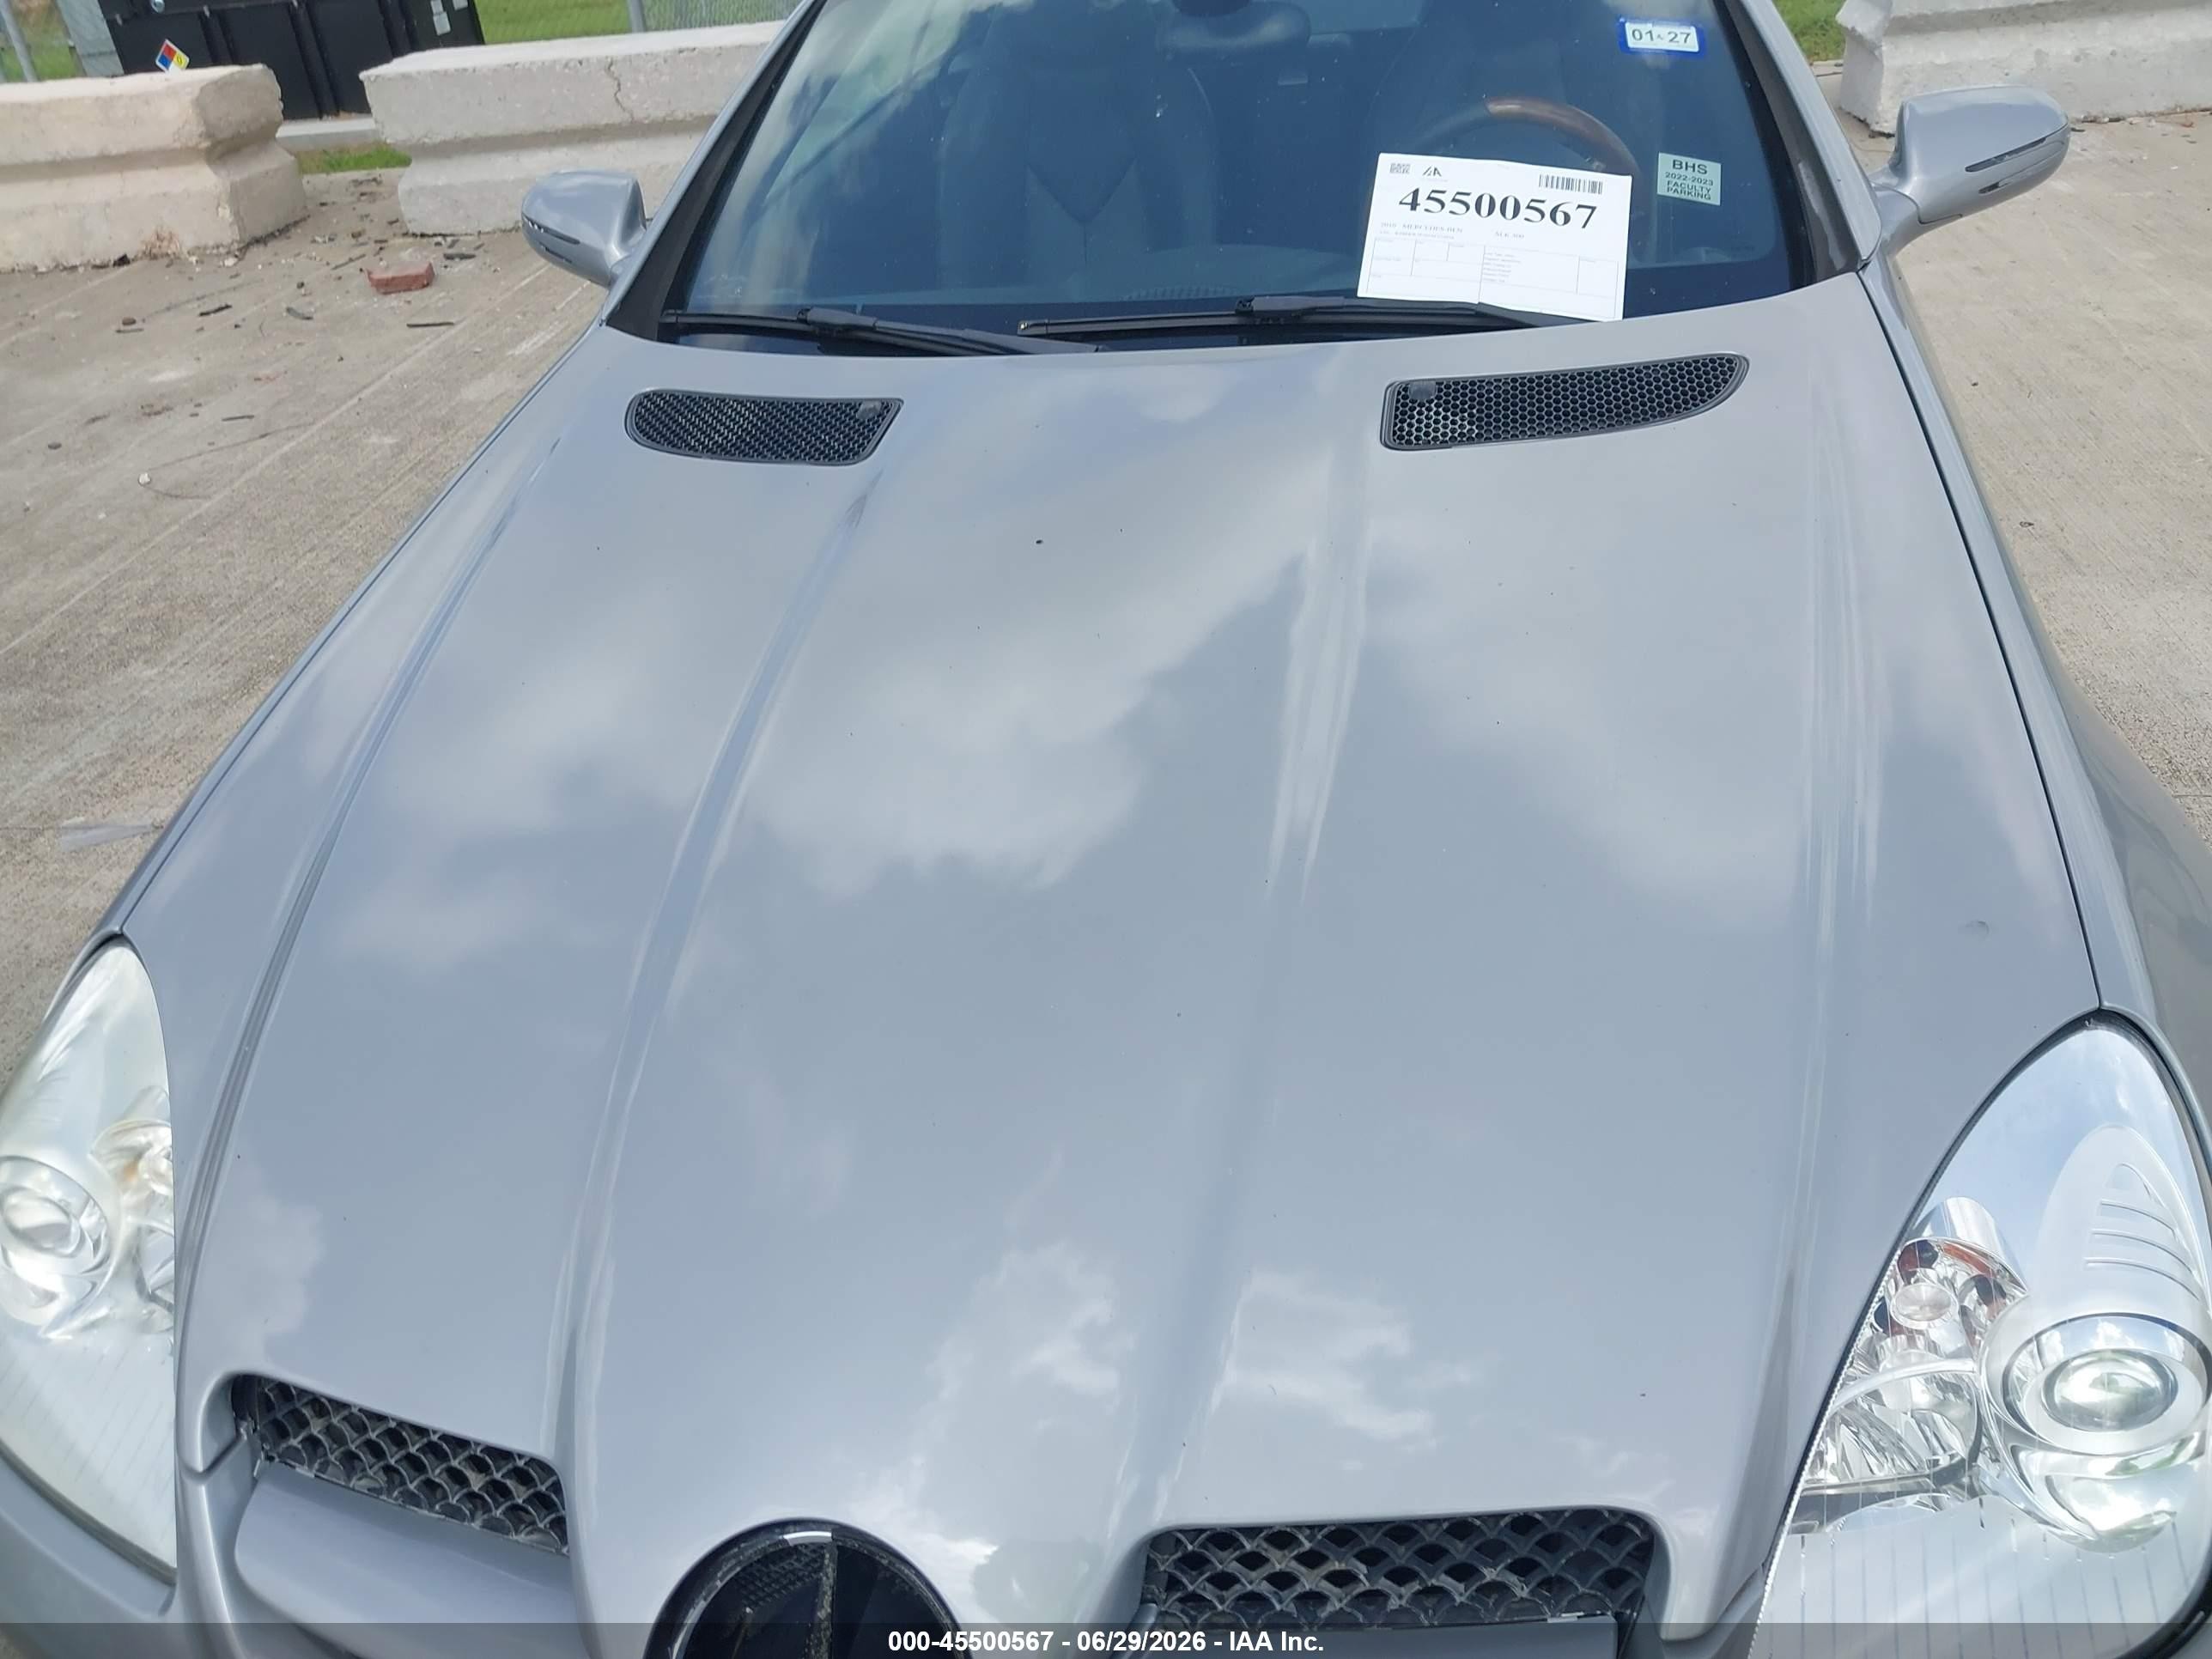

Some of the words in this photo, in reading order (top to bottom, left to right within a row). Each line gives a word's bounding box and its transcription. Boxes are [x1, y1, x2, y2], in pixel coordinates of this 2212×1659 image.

[1632, 28, 1654, 42] 01
[1668, 31, 1692, 44] 27
[1672, 159, 1708, 175] BHS
[1665, 171, 1714, 186] 2022-2023
[1667, 180, 1711, 194] FACULTY
[1667, 186, 1711, 201] PARKING
[1399, 186, 1597, 229] 45500567
